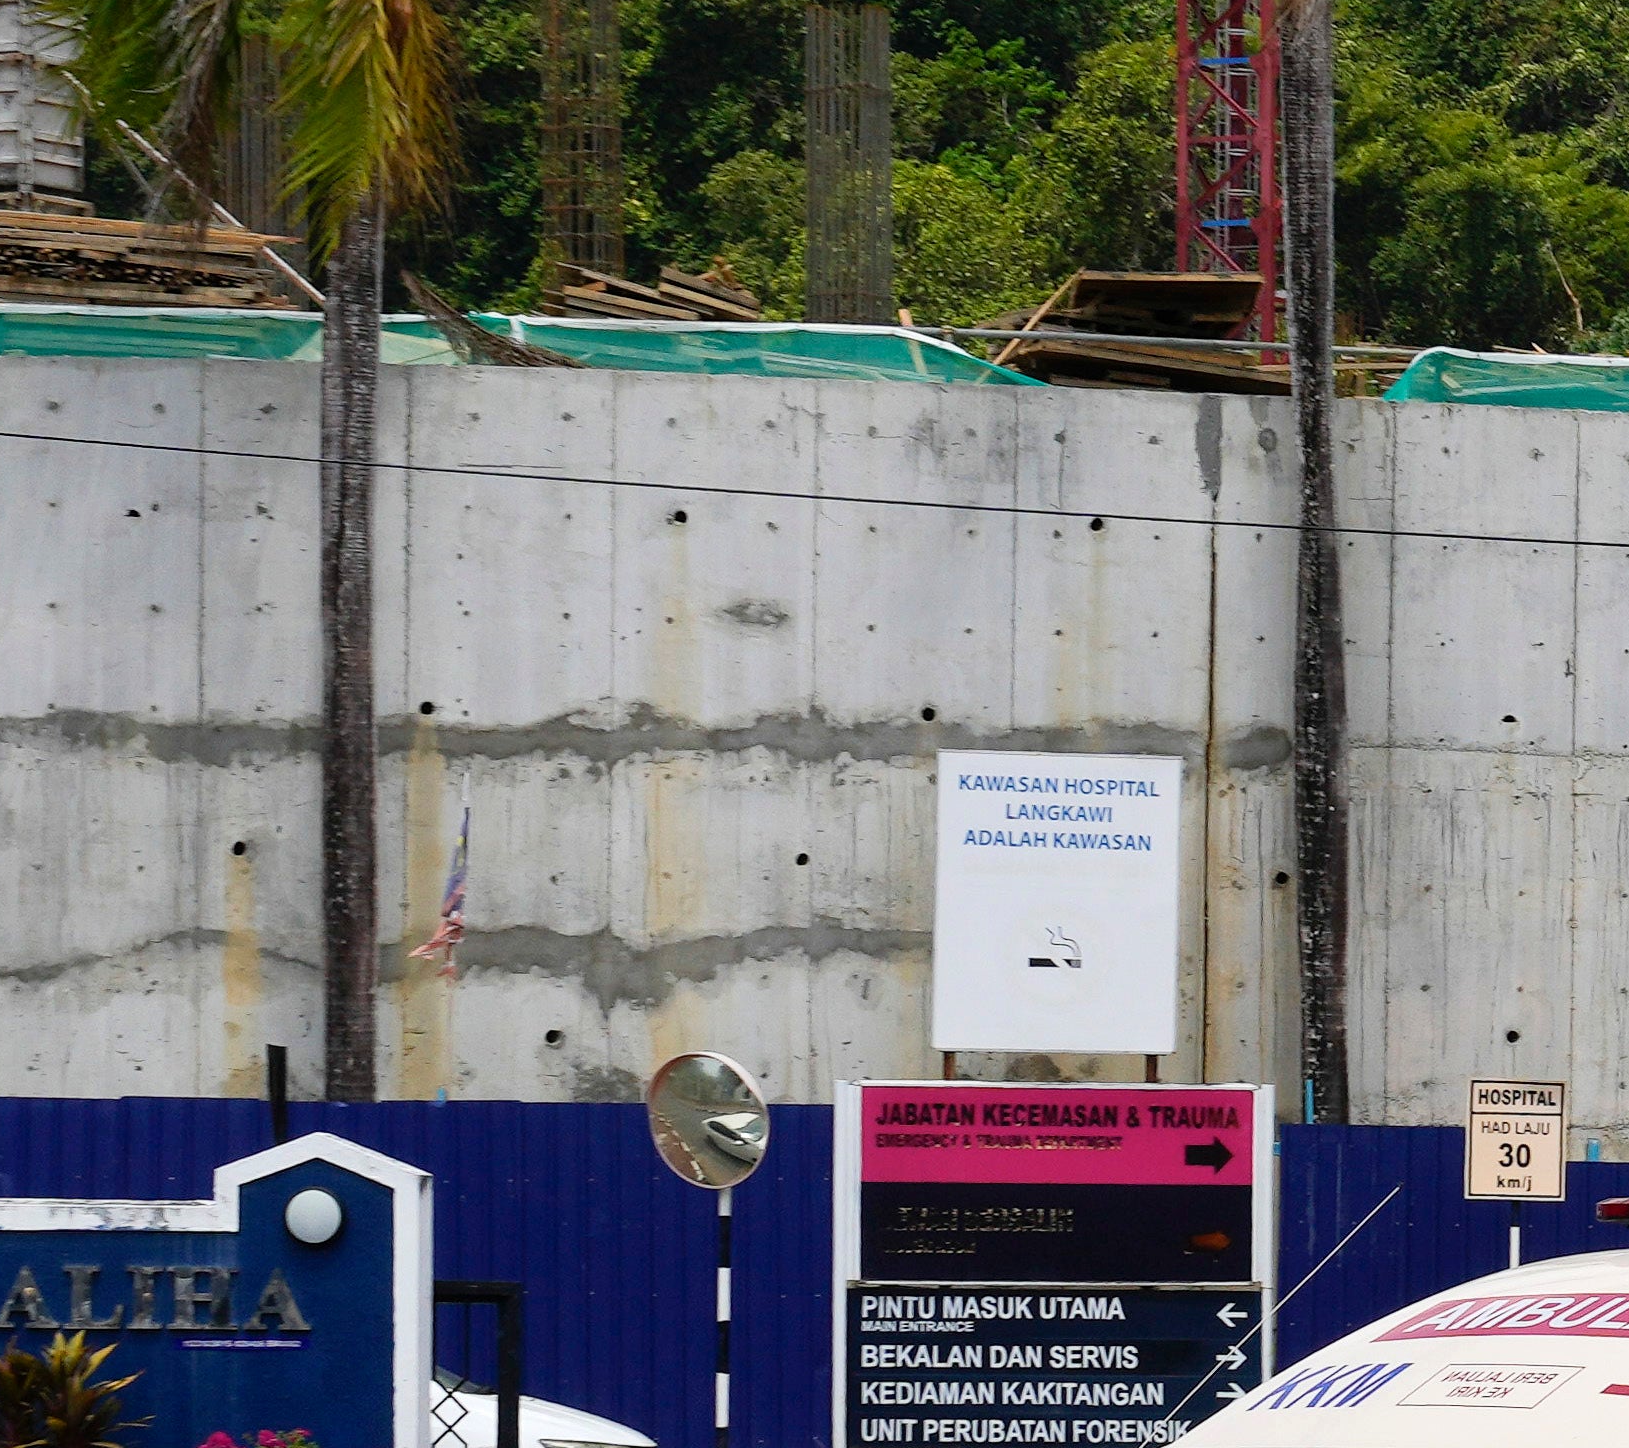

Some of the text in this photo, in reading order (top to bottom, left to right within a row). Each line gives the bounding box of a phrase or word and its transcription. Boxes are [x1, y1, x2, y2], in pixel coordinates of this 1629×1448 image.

[958, 774, 1160, 798] KAWASAN HOSPITAL
[1005, 803, 1113, 823] LANGKAWI
[963, 830, 1151, 851] ADALAH KAWASAN
[1478, 1088, 1557, 1107] HOSPITAL
[876, 1103, 1241, 1129] JABATAN KECEMASAN & TRAUMA
[1481, 1121, 1551, 1136] HAD LAJU
[1498, 1143, 1531, 1168] 30
[1496, 1175, 1533, 1192] km/j
[861, 1295, 1126, 1320] PINTU MASUK UTAMA
[861, 1320, 975, 1333] MAIN ENTRANCE
[861, 1344, 1140, 1370] BEKALAN DAN SERVIS
[861, 1381, 1165, 1406] KEDIAMAN KAKITANGAN
[1246, 1362, 1415, 1411] KKM
[861, 1418, 1192, 1443] UNIT PERUBATAN FORENSIK
